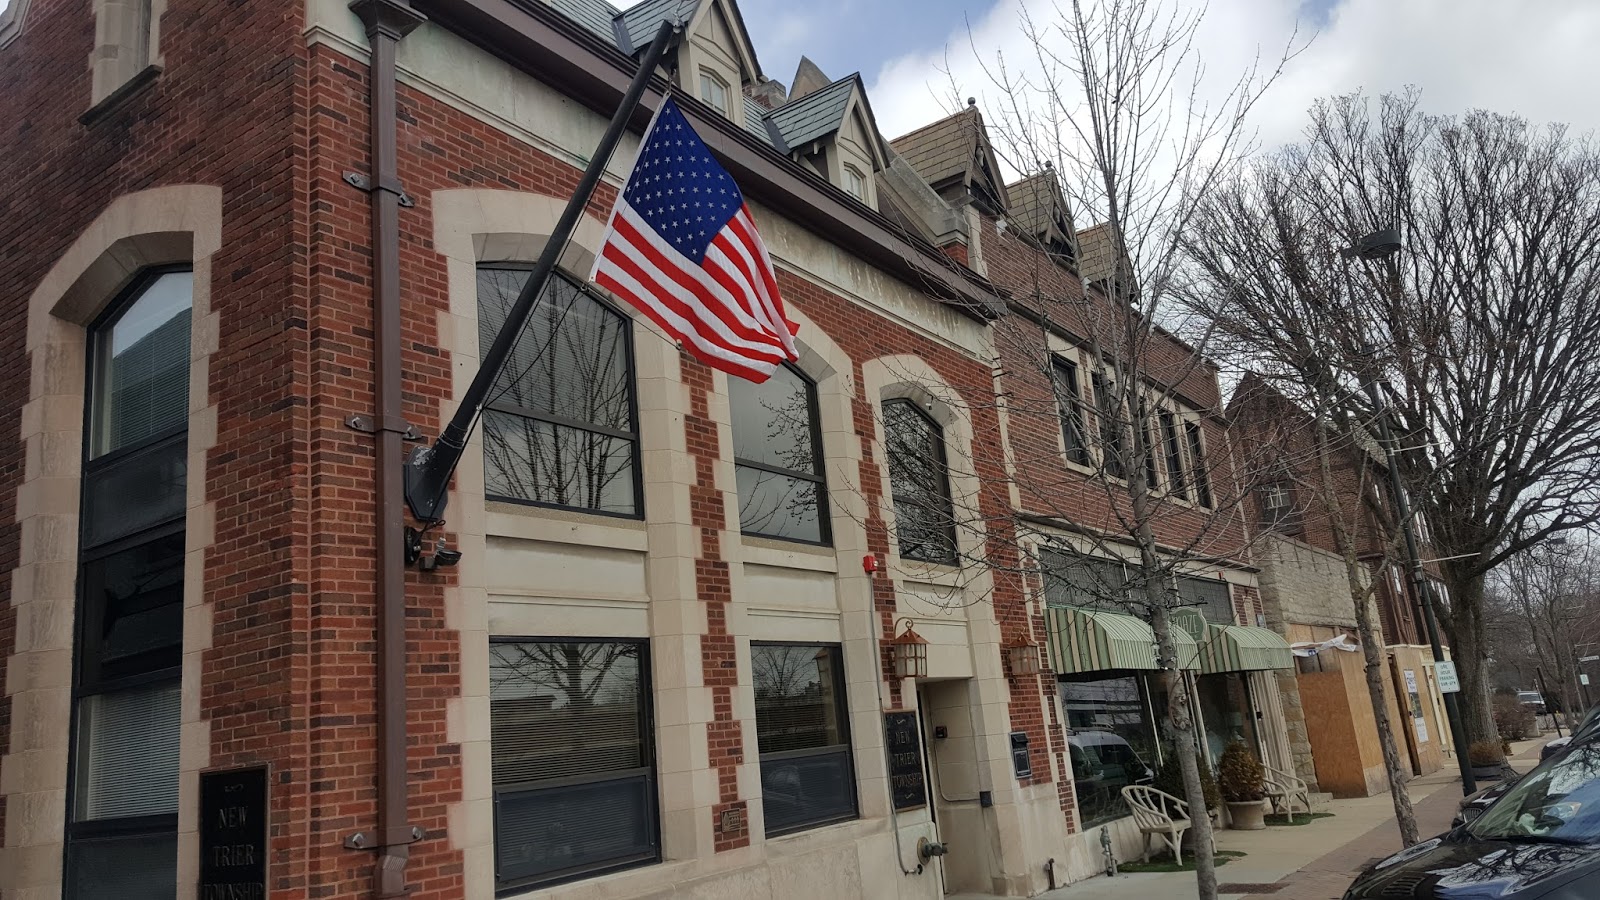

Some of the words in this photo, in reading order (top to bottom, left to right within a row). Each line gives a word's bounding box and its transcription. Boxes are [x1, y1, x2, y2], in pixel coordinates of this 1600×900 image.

[895, 730, 910, 744] NEW
[894, 751, 916, 767] TRIER
[893, 772, 922, 789] TOWNSHIP
[219, 805, 248, 829] NEW
[213, 843, 254, 867] TRIER
[203, 882, 263, 900] TOWNSHIP
